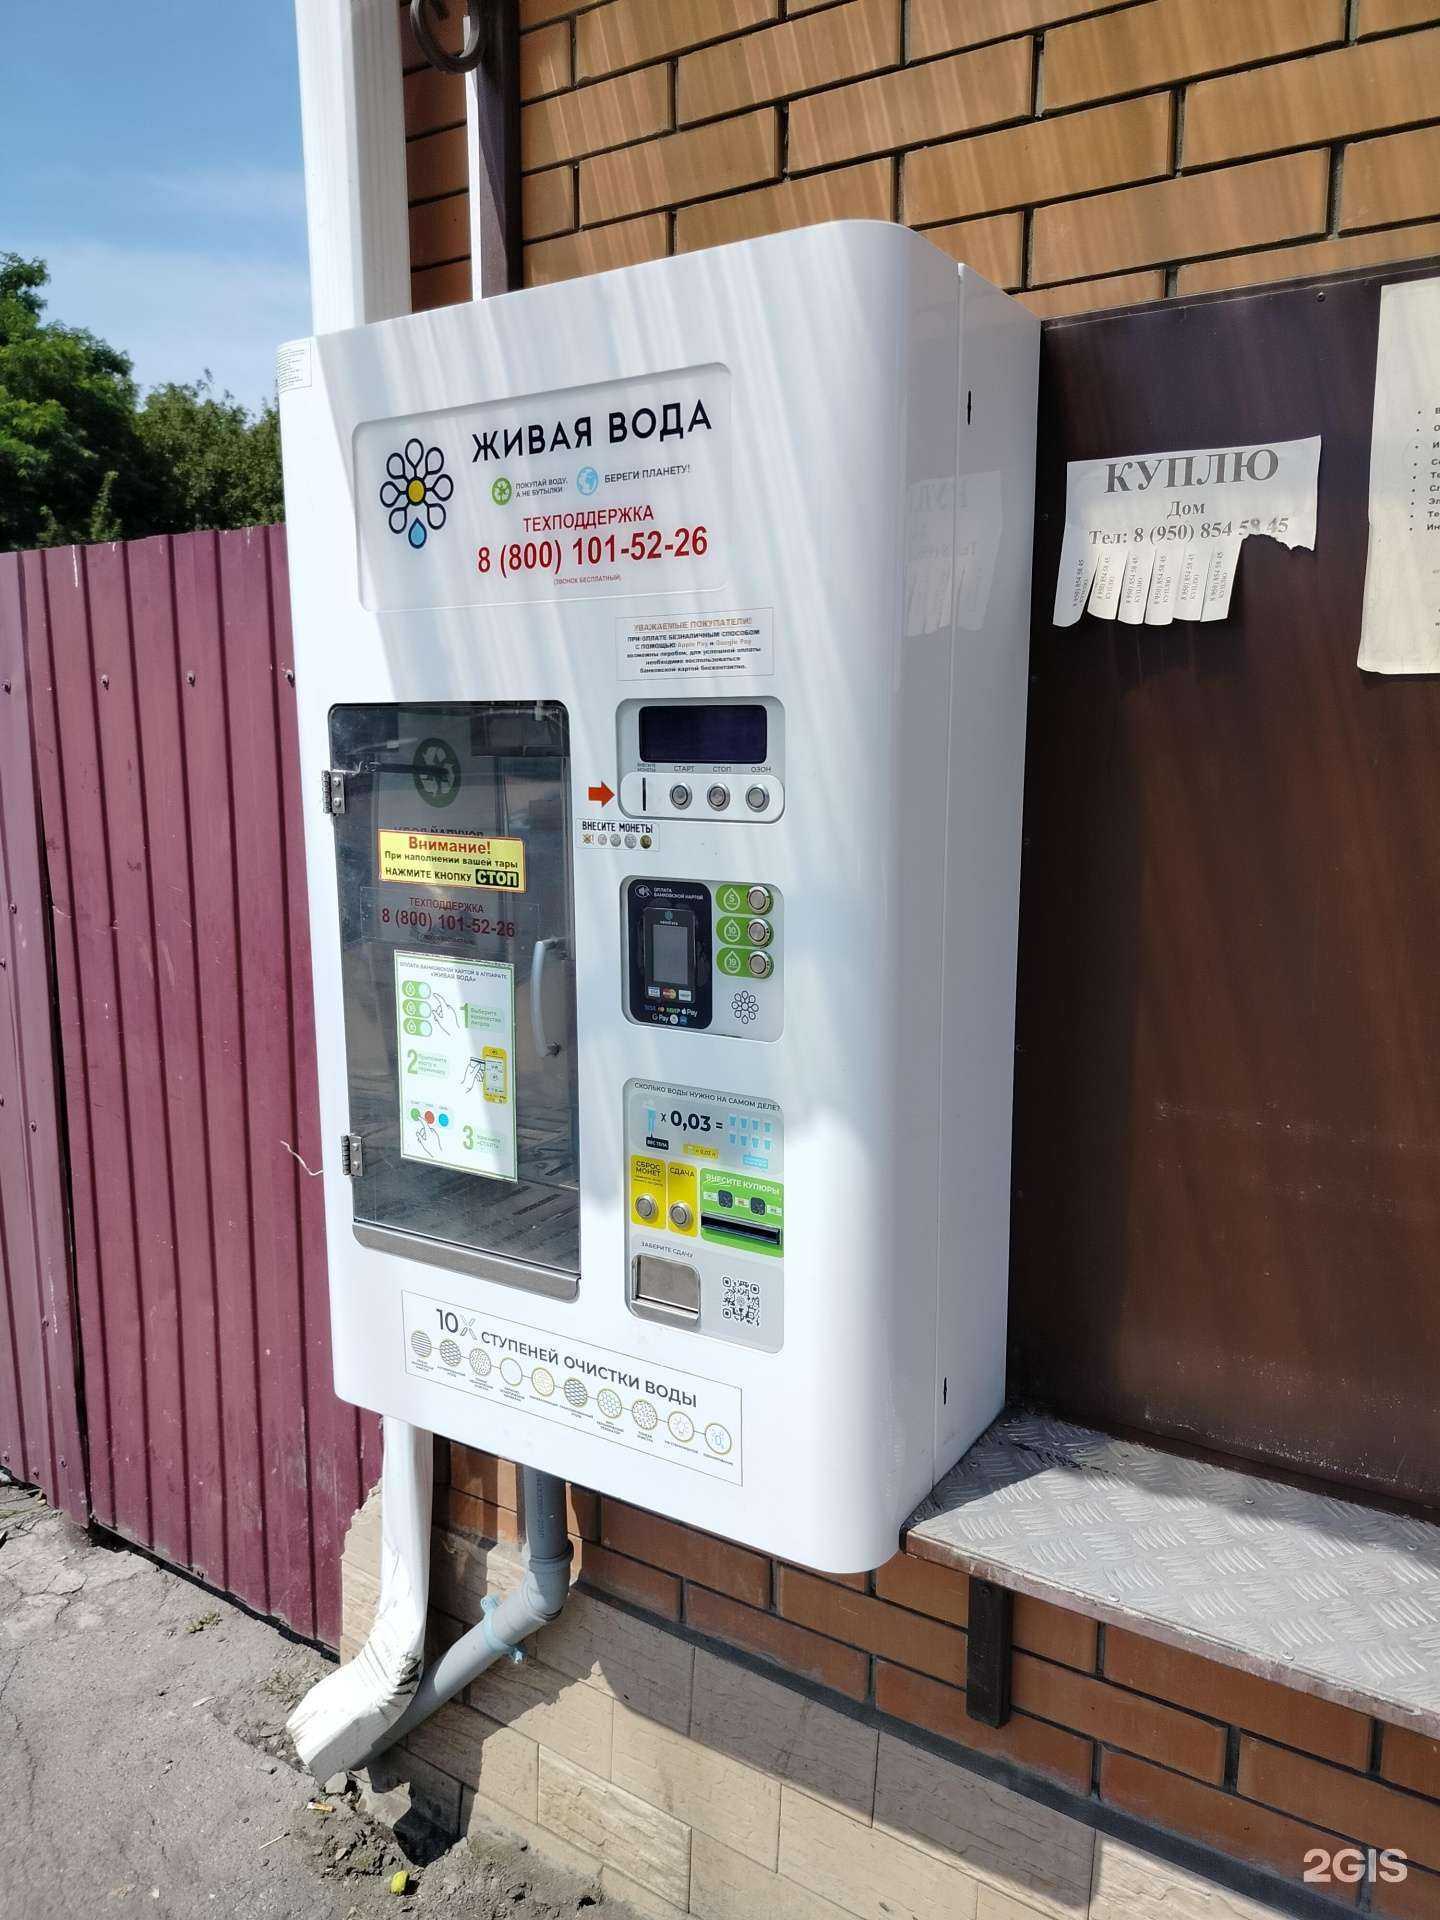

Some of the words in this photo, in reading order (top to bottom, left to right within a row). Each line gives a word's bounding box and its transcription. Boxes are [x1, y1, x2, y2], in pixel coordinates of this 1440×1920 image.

[472, 416, 592, 463] ЖИВАЯ
[609, 399, 712, 444] ВОДА
[604, 470, 640, 484] БЕРЕГИ
[642, 464, 691, 480] ПЛАНЕТУ!
[1104, 449, 1279, 493] КУПЛЮ
[515, 478, 547, 489] ПОКУПАЙ
[532, 486, 563, 496] БУТЫЛКИ
[523, 505, 654, 533] ТЕХПОДДЕРЖКА
[1167, 500, 1205, 519] Дом
[1088, 530, 1127, 545] Тел:
[1134, 528, 1144, 543] 8
[1150, 524, 1195, 545] (950)
[1200, 520, 1232, 539] 854
[477, 546, 491, 574] 8
[500, 539, 562, 578] (800)
[572, 526, 708, 565] 101-52-26
[751, 766, 772, 774] ОЗОН
[582, 821, 616, 832] ВНЕСИТЕ
[618, 822, 654, 834] МОНЕТЫ
[408, 836, 492, 854] Внимание!
[384, 851, 401, 860] При
[404, 854, 460, 864] наполнении
[462, 858, 492, 867] вашей
[495, 860, 518, 870] тары
[385, 867, 431, 879] НАЖМИТЕ
[434, 872, 472, 882] КНОПКУ
[476, 870, 518, 887] СТОП
[409, 897, 484, 914] ТЕХПОДДЕРЖКА
[382, 908, 390, 923] 8
[395, 909, 432, 931] (800)
[438, 914, 516, 938] 101-52-26
[460, 1003, 468, 1028] 1
[659, 1014, 670, 1024] Pay
[687, 1008, 698, 1018] Pay
[408, 1048, 418, 1074] 2
[635, 1082, 666, 1093] СКОЛЬКО
[668, 1087, 688, 1096] ВОДЫ
[690, 1090, 716, 1100] НУЖНО
[728, 1097, 756, 1108] САМОМ
[758, 1101, 780, 1112] ДЕЛЕ?
[670, 1110, 711, 1132] 0,03
[462, 1124, 474, 1150] 3
[636, 1161, 660, 1170] СБРОС
[636, 1167, 661, 1176] МОНЕТ
[669, 1168, 695, 1178] СДАЧА
[706, 1175, 742, 1187] ВНЕСИТЕ
[744, 1181, 780, 1194] КУПЮРЫ
[642, 1241, 672, 1253] ЗАБЕРИТЕ
[481, 1330, 559, 1366] СТУПЕНЕЙ
[564, 1356, 640, 1390] ОЧИСТКИ
[646, 1382, 697, 1408] ВОДЫ
